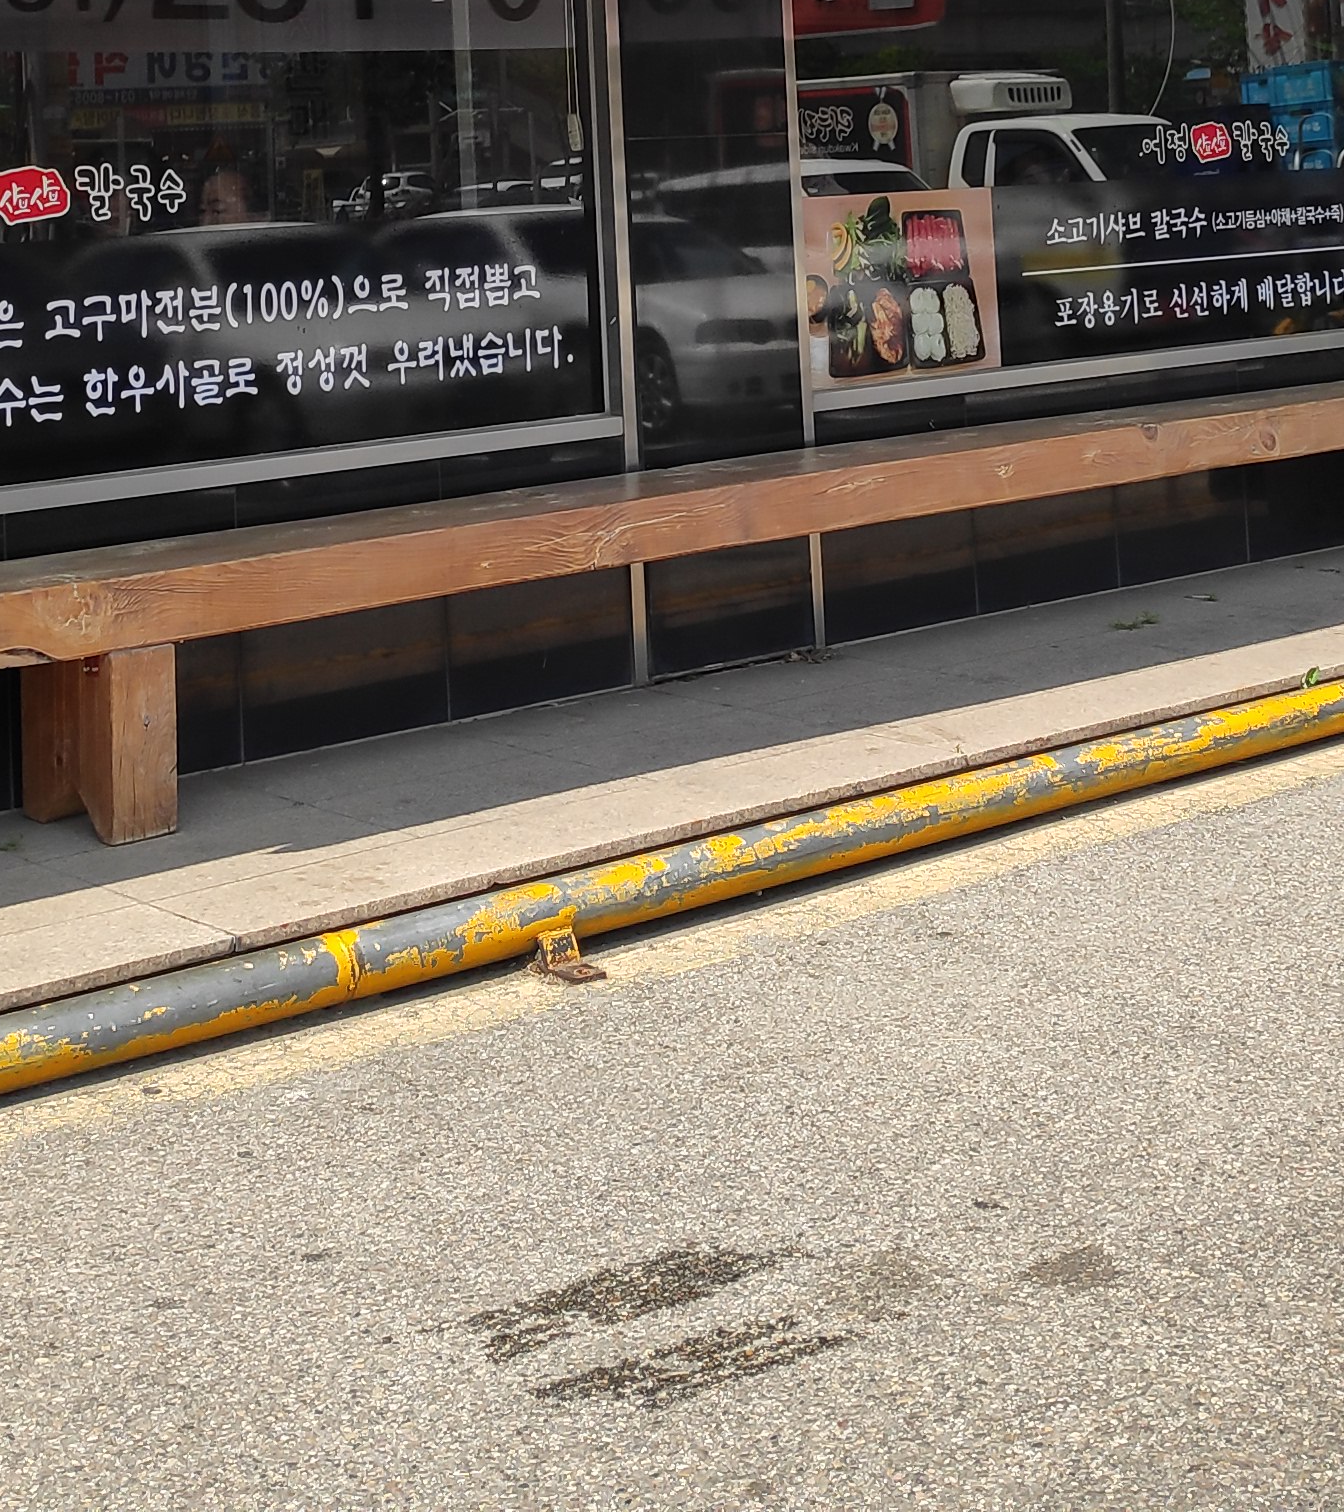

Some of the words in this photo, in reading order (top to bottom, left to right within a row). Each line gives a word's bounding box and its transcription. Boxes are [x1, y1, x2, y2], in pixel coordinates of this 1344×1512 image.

[1232, 120, 1290, 162] 칼국수
[74, 163, 187, 222] 칼국수
[1046, 212, 1146, 246] 소고기샤브
[1151, 206, 1208, 240] 칼국수
[44, 272, 409, 341] 고구마전분(100%)으로
[424, 263, 541, 312] 직접뽑고
[1054, 289, 1164, 329] 포장용기로
[1169, 277, 1249, 320] 신선하게
[82, 356, 258, 418] 한우사골로
[276, 343, 370, 396] 정성껏
[386, 325, 574, 385] 우려냈습니다.
